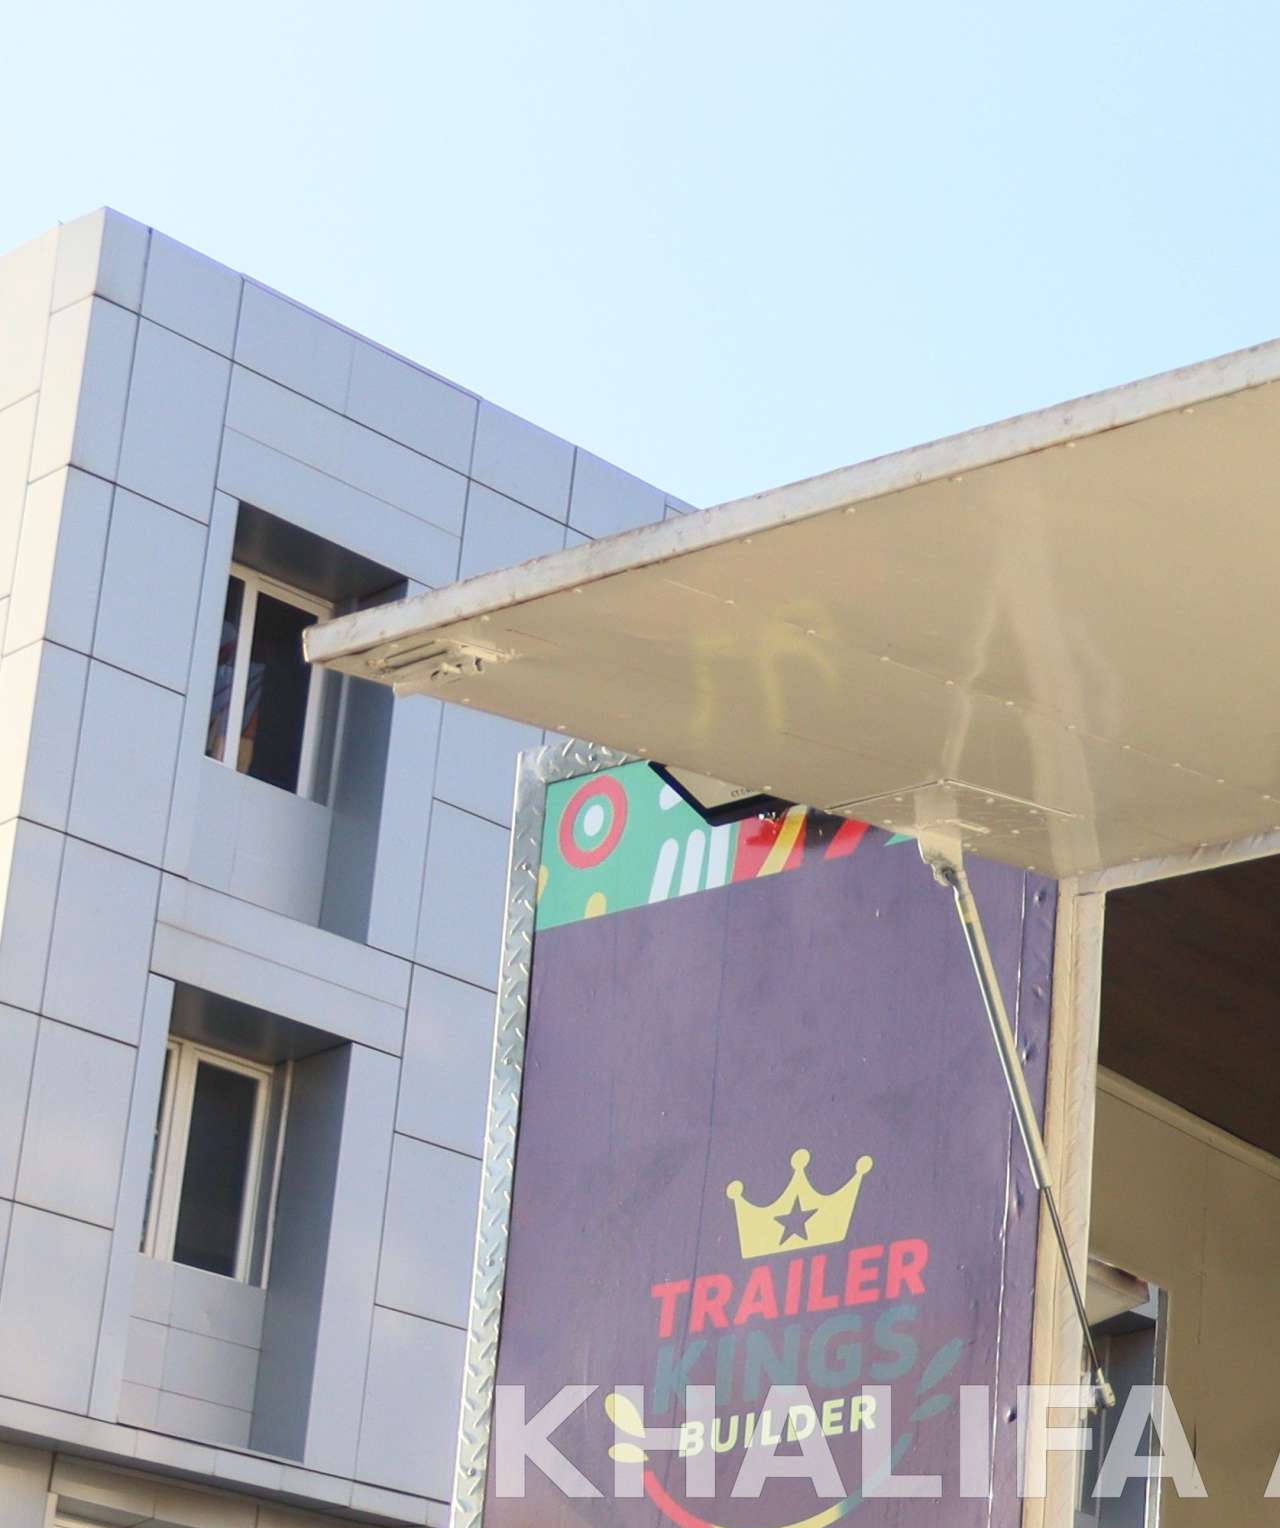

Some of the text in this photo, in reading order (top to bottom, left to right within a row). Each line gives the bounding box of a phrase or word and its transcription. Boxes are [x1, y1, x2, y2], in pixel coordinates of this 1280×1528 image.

[650, 1238, 929, 1338] TRAILER
[651, 1304, 919, 1416] KINGS
[678, 1395, 878, 1458] BUILDER
